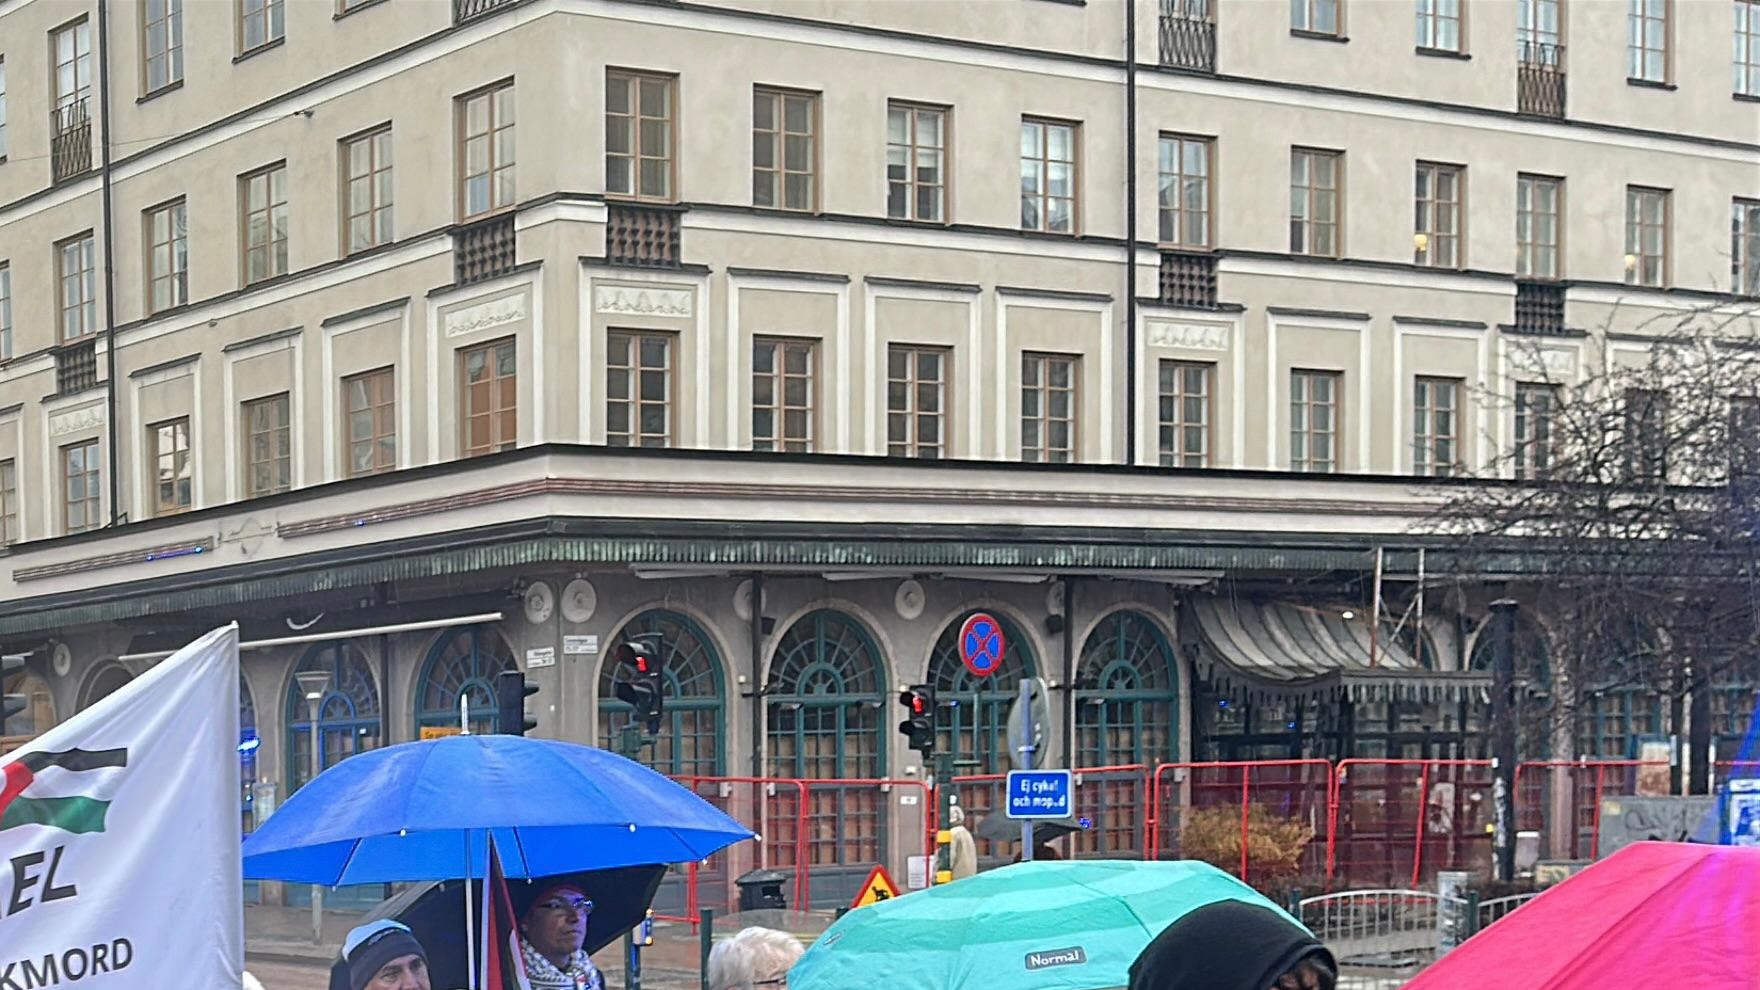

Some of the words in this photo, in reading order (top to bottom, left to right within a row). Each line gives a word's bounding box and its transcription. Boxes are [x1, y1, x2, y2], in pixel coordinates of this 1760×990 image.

[1021, 779, 1030, 794] Ej
[1013, 795, 1030, 807] och
[1030, 950, 1079, 967] Normal
